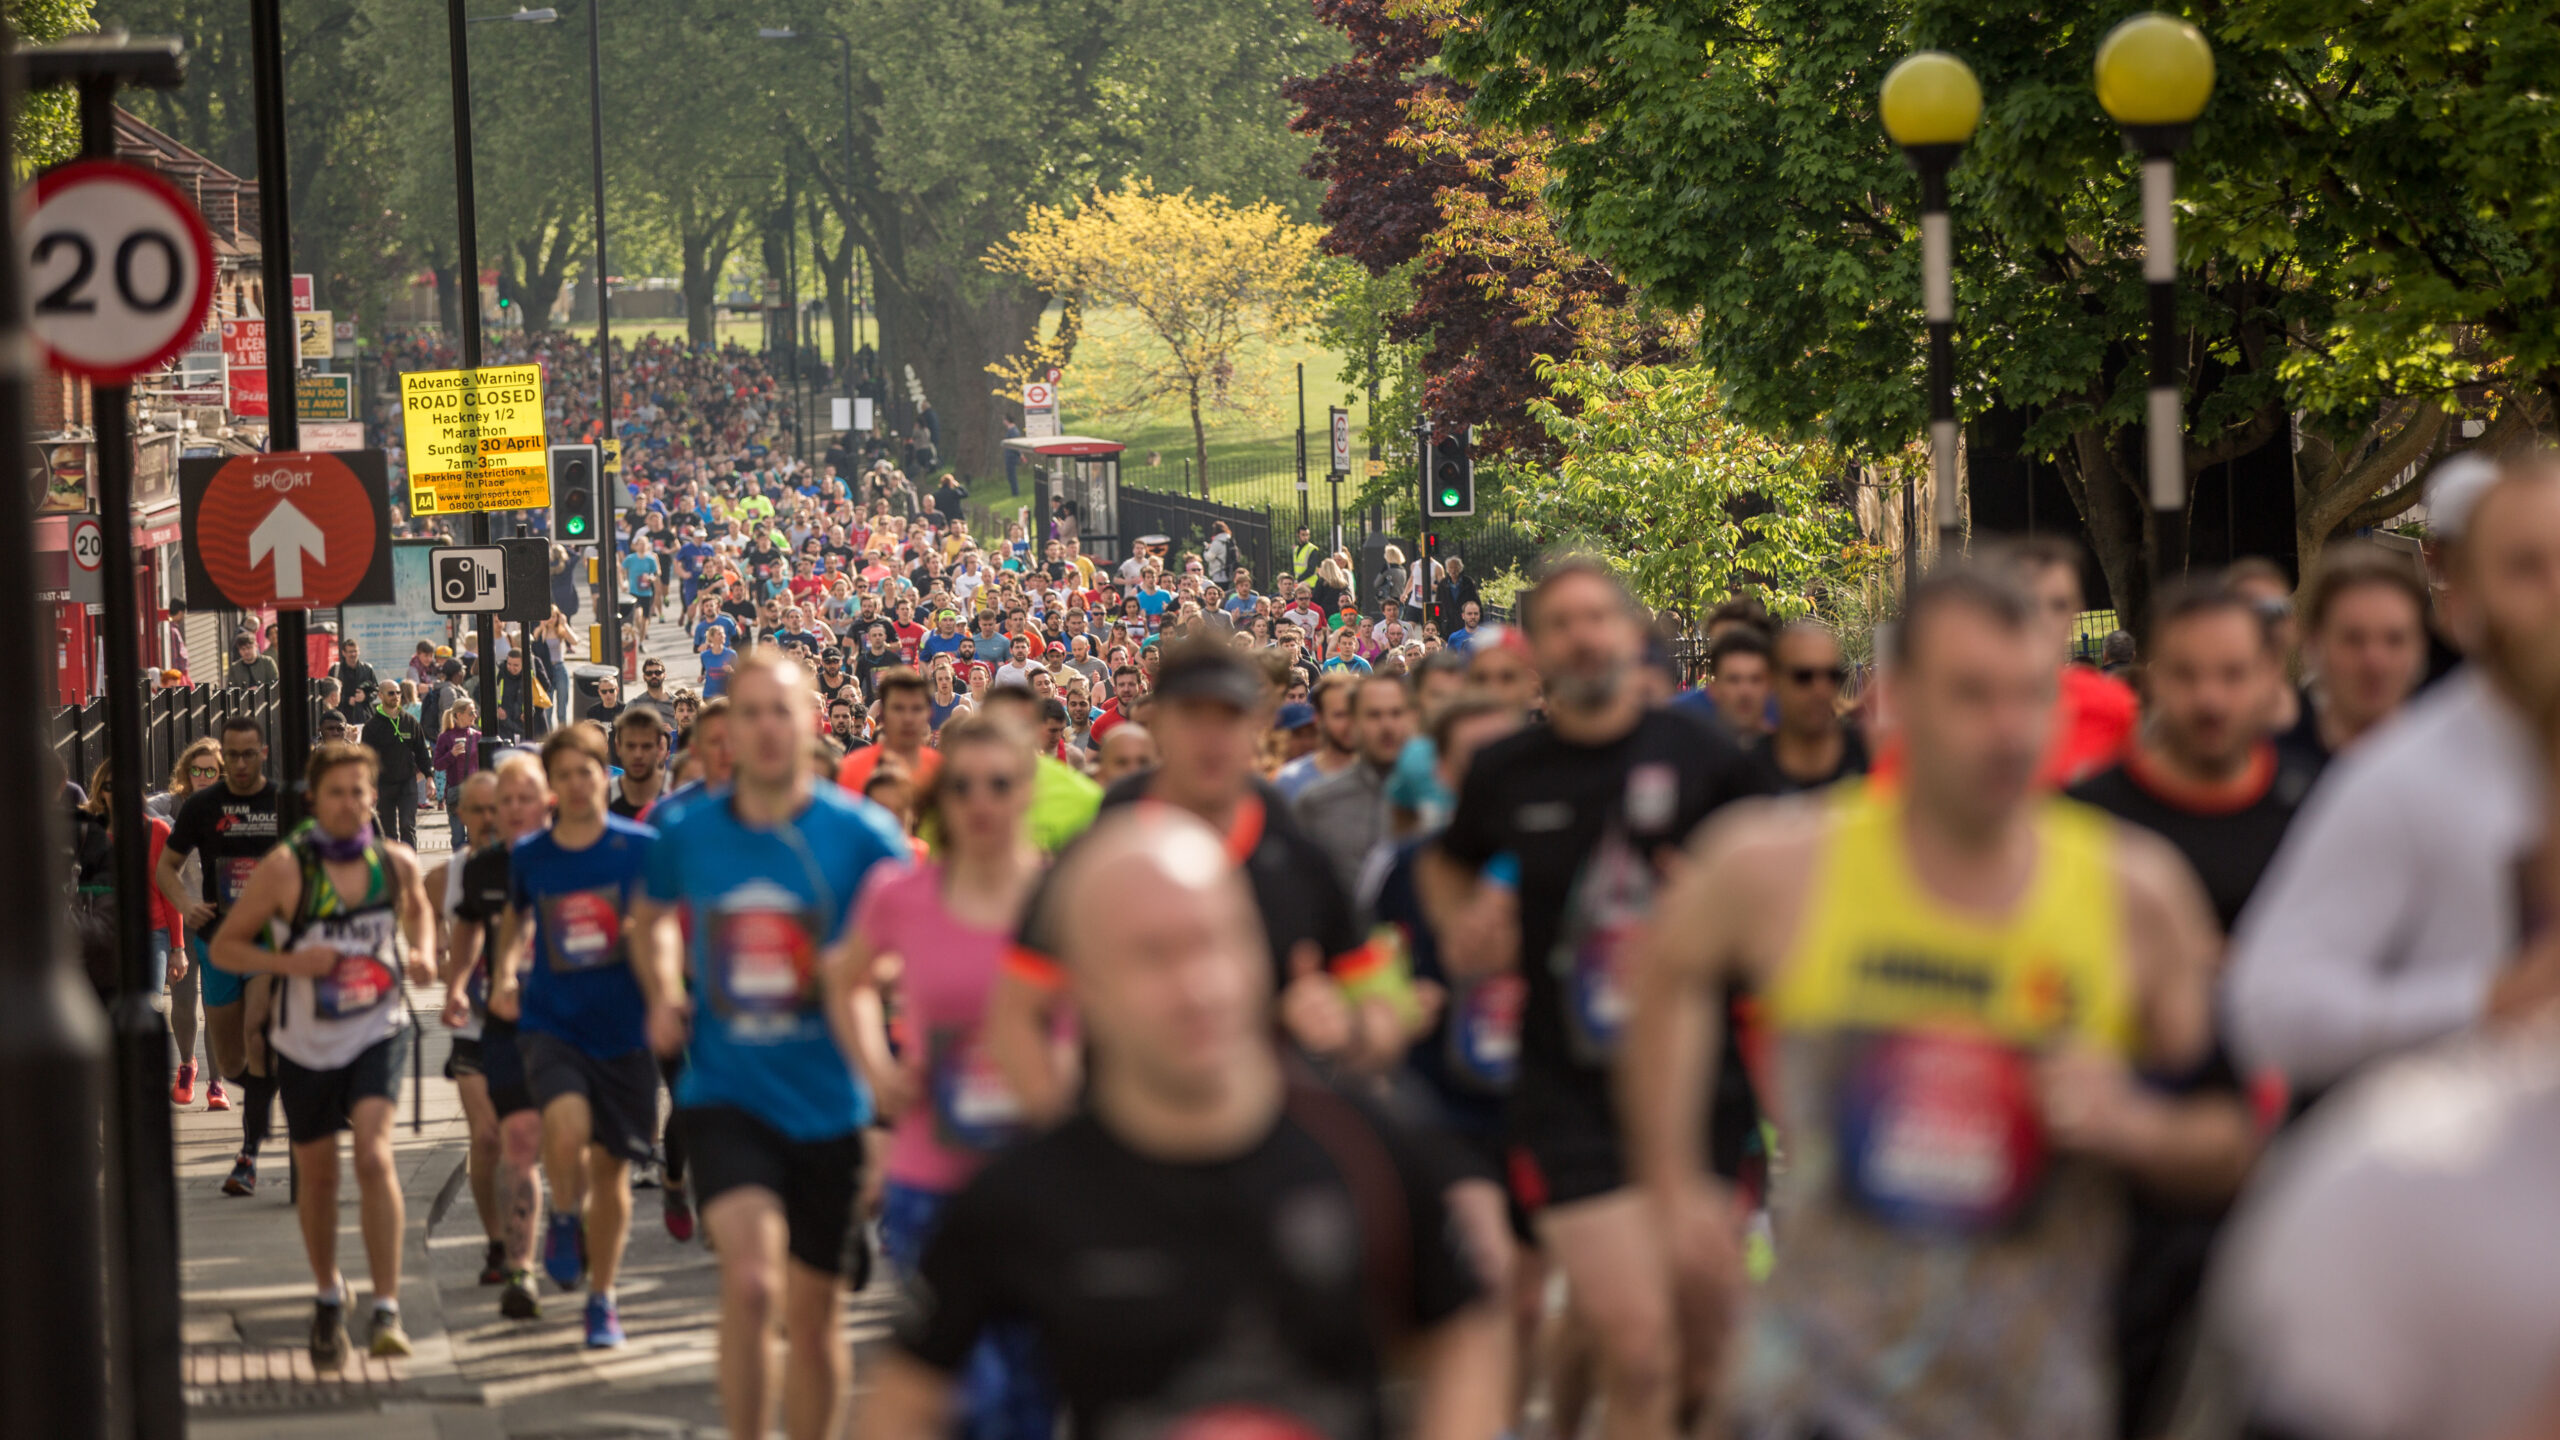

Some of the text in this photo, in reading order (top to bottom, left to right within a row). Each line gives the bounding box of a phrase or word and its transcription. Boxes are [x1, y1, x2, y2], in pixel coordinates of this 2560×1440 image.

[31, 229, 184, 316] 20
[236, 338, 265, 350] LICEN
[408, 371, 535, 390] Advance Warning
[319, 388, 346, 398] FOOD
[409, 389, 536, 410] ROAD CLOSED
[432, 408, 515, 424] Hackney 1/2
[443, 426, 507, 439] Marathon
[428, 436, 541, 456] Sunday 30 April
[446, 456, 508, 470] 7am-3pm
[424, 469, 526, 483] Parking Restrictions
[479, 479, 505, 488] Place
[418, 496, 433, 507] AA
[449, 501, 475, 510] 0800
[77, 536, 101, 556] 20
[221, 805, 250, 814] TEAM
